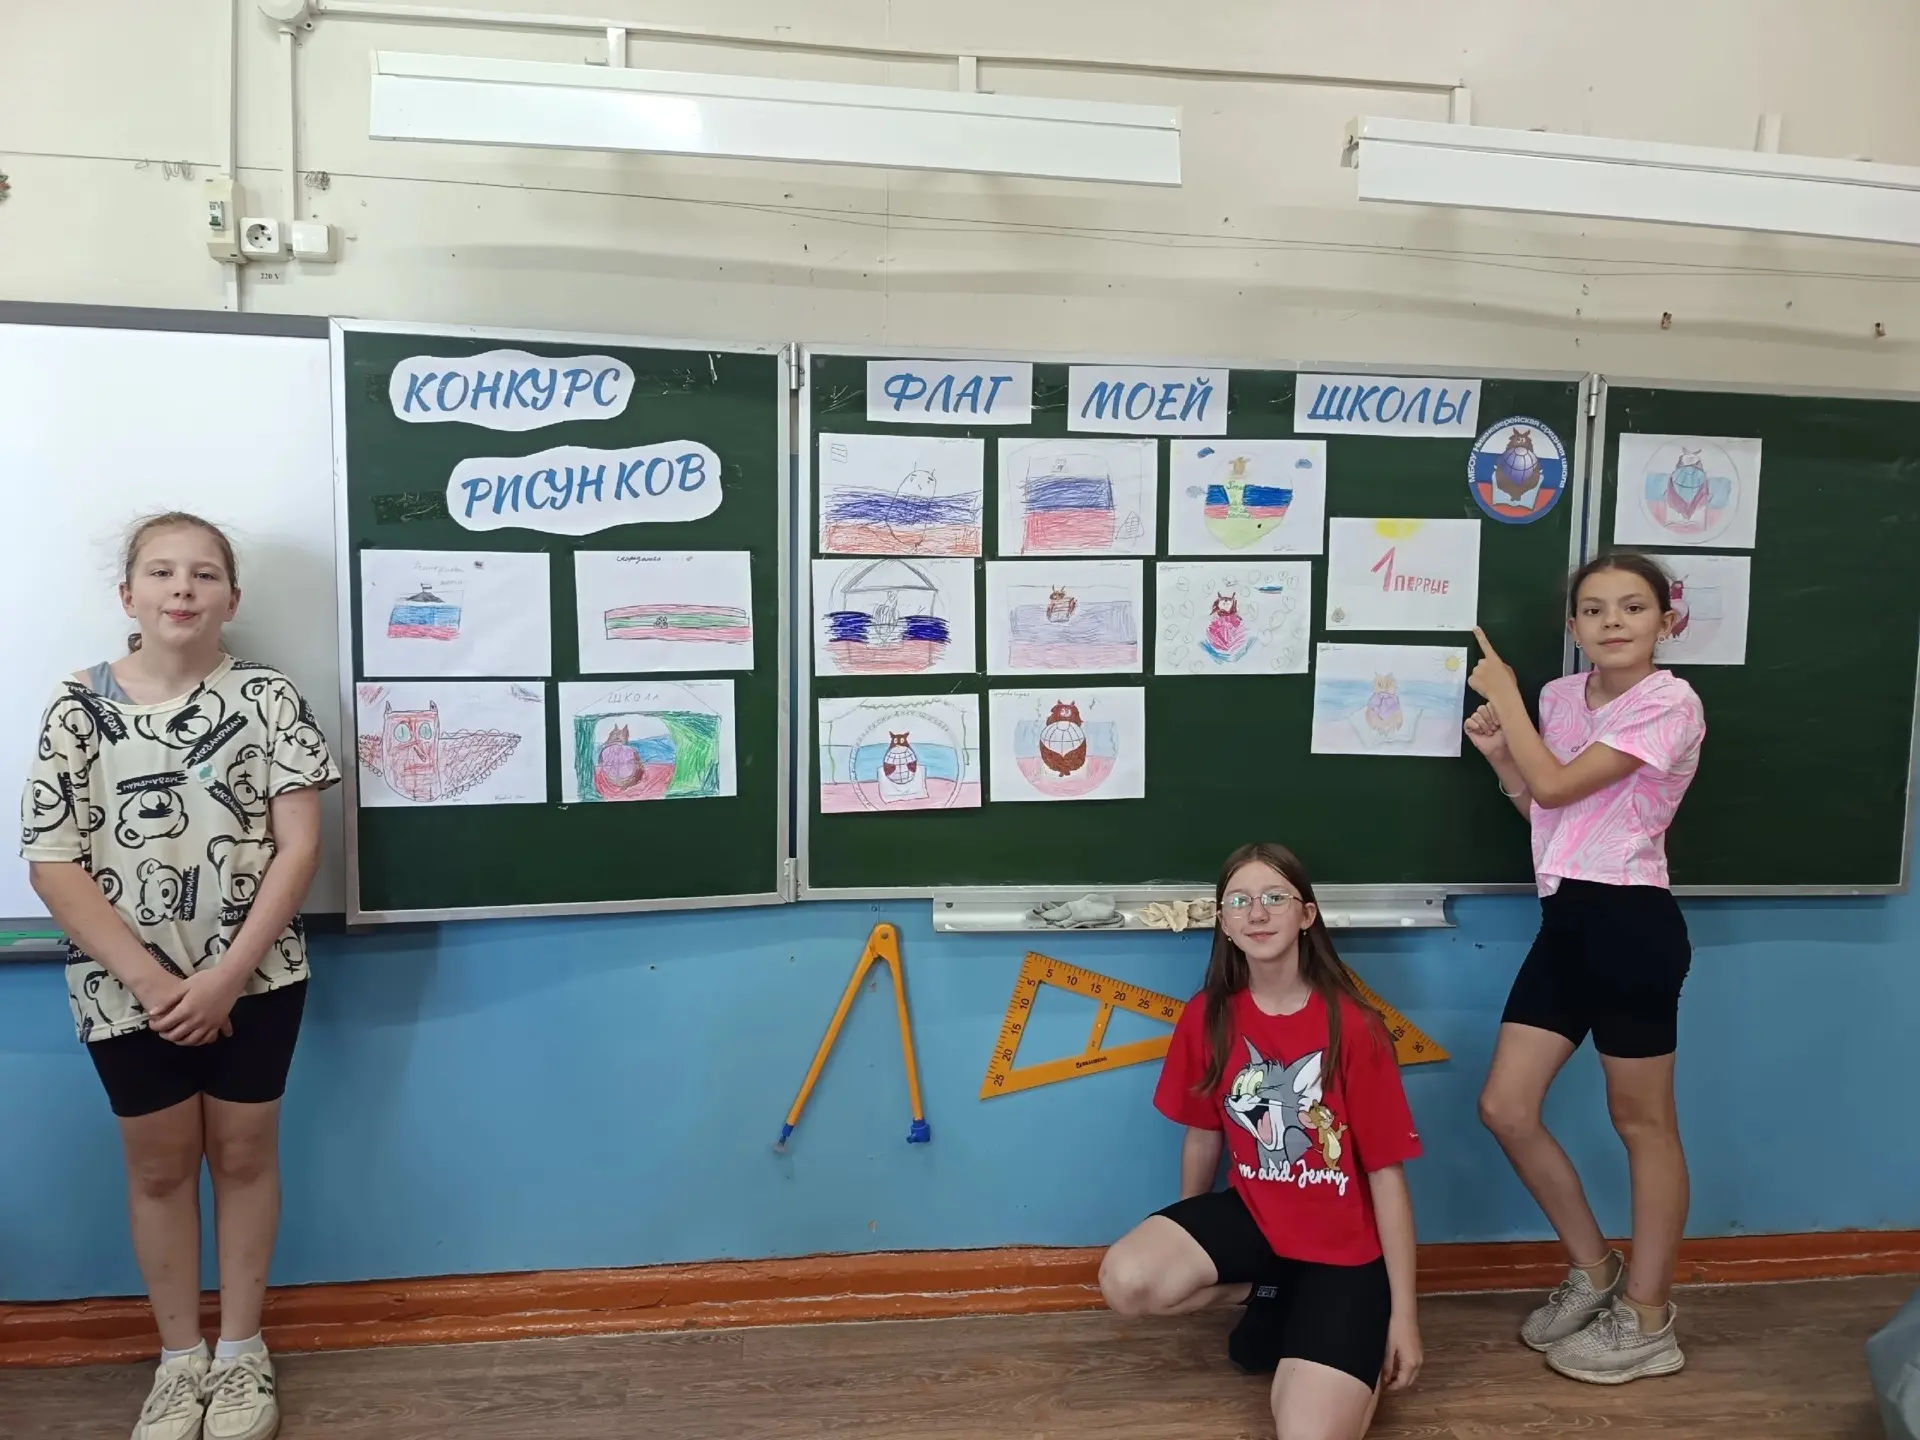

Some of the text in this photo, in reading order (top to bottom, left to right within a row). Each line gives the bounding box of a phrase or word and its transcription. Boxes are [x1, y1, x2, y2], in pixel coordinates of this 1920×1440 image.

[261, 272, 273, 280] 220
[403, 367, 621, 413] КОНКУРС
[884, 373, 1472, 425] ФЛАГ МОЕЙ ШКОЛЫ
[460, 453, 706, 518] РИСУНКОВ
[1468, 452, 1477, 483] МБОУ
[1393, 575, 1450, 595] ПЕРВЫЕ
[1046, 968, 1174, 1018] 5 10 15 20 25 30
[993, 979, 1036, 1087] 25 20 15 10 5
[1393, 1026, 1424, 1054] 25 30
[1258, 1161, 1295, 1182] and
[1296, 1159, 1349, 1196] Jerry
